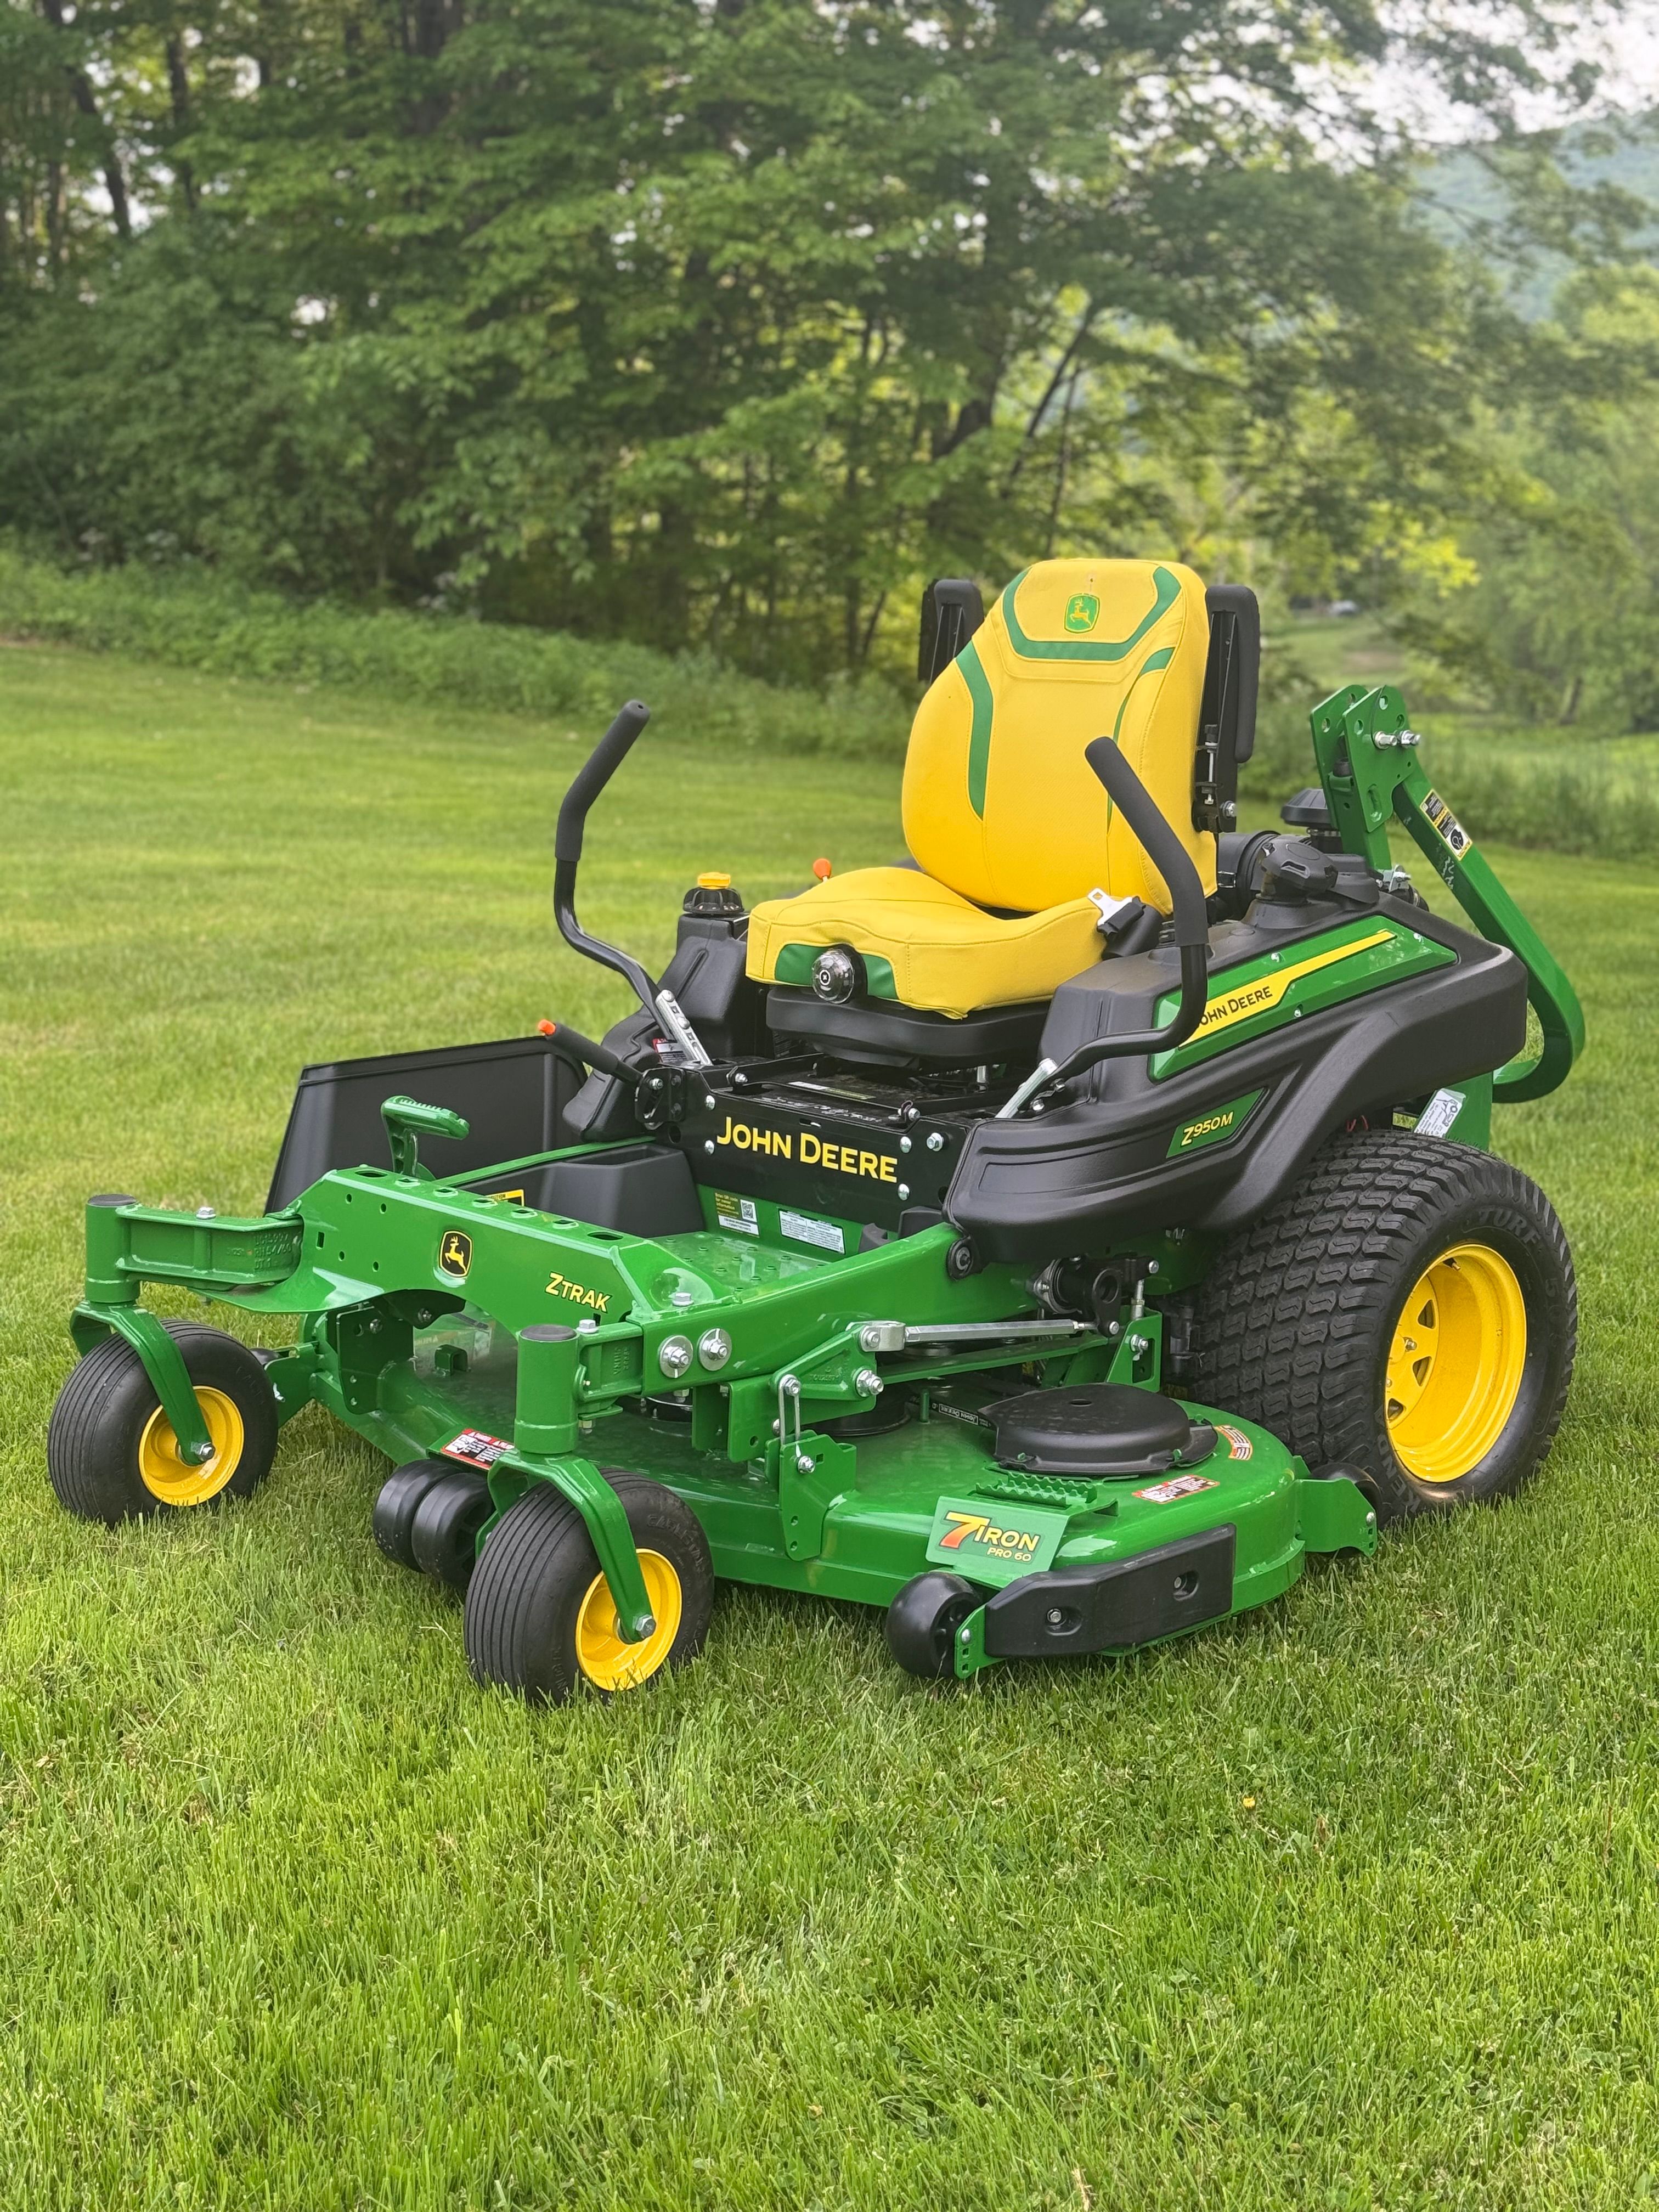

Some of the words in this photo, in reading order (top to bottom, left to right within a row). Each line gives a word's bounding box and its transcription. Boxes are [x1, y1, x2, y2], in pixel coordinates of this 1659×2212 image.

[1199, 1005, 1228, 1026] OHN
[1227, 986, 1273, 1013] DEERE
[1181, 1111, 1234, 1146] Z950M
[716, 1116, 792, 1159] JOHN
[799, 1132, 898, 1183] DEERE
[545, 1272, 611, 1313] ZTRAK
[941, 1406, 960, 1417] DEERE
[961, 1412, 977, 1423] JOHN
[1374, 1404, 1421, 1514] KENDA
[986, 1547, 1013, 1559] PRO
[1014, 1552, 1032, 1562] 60
